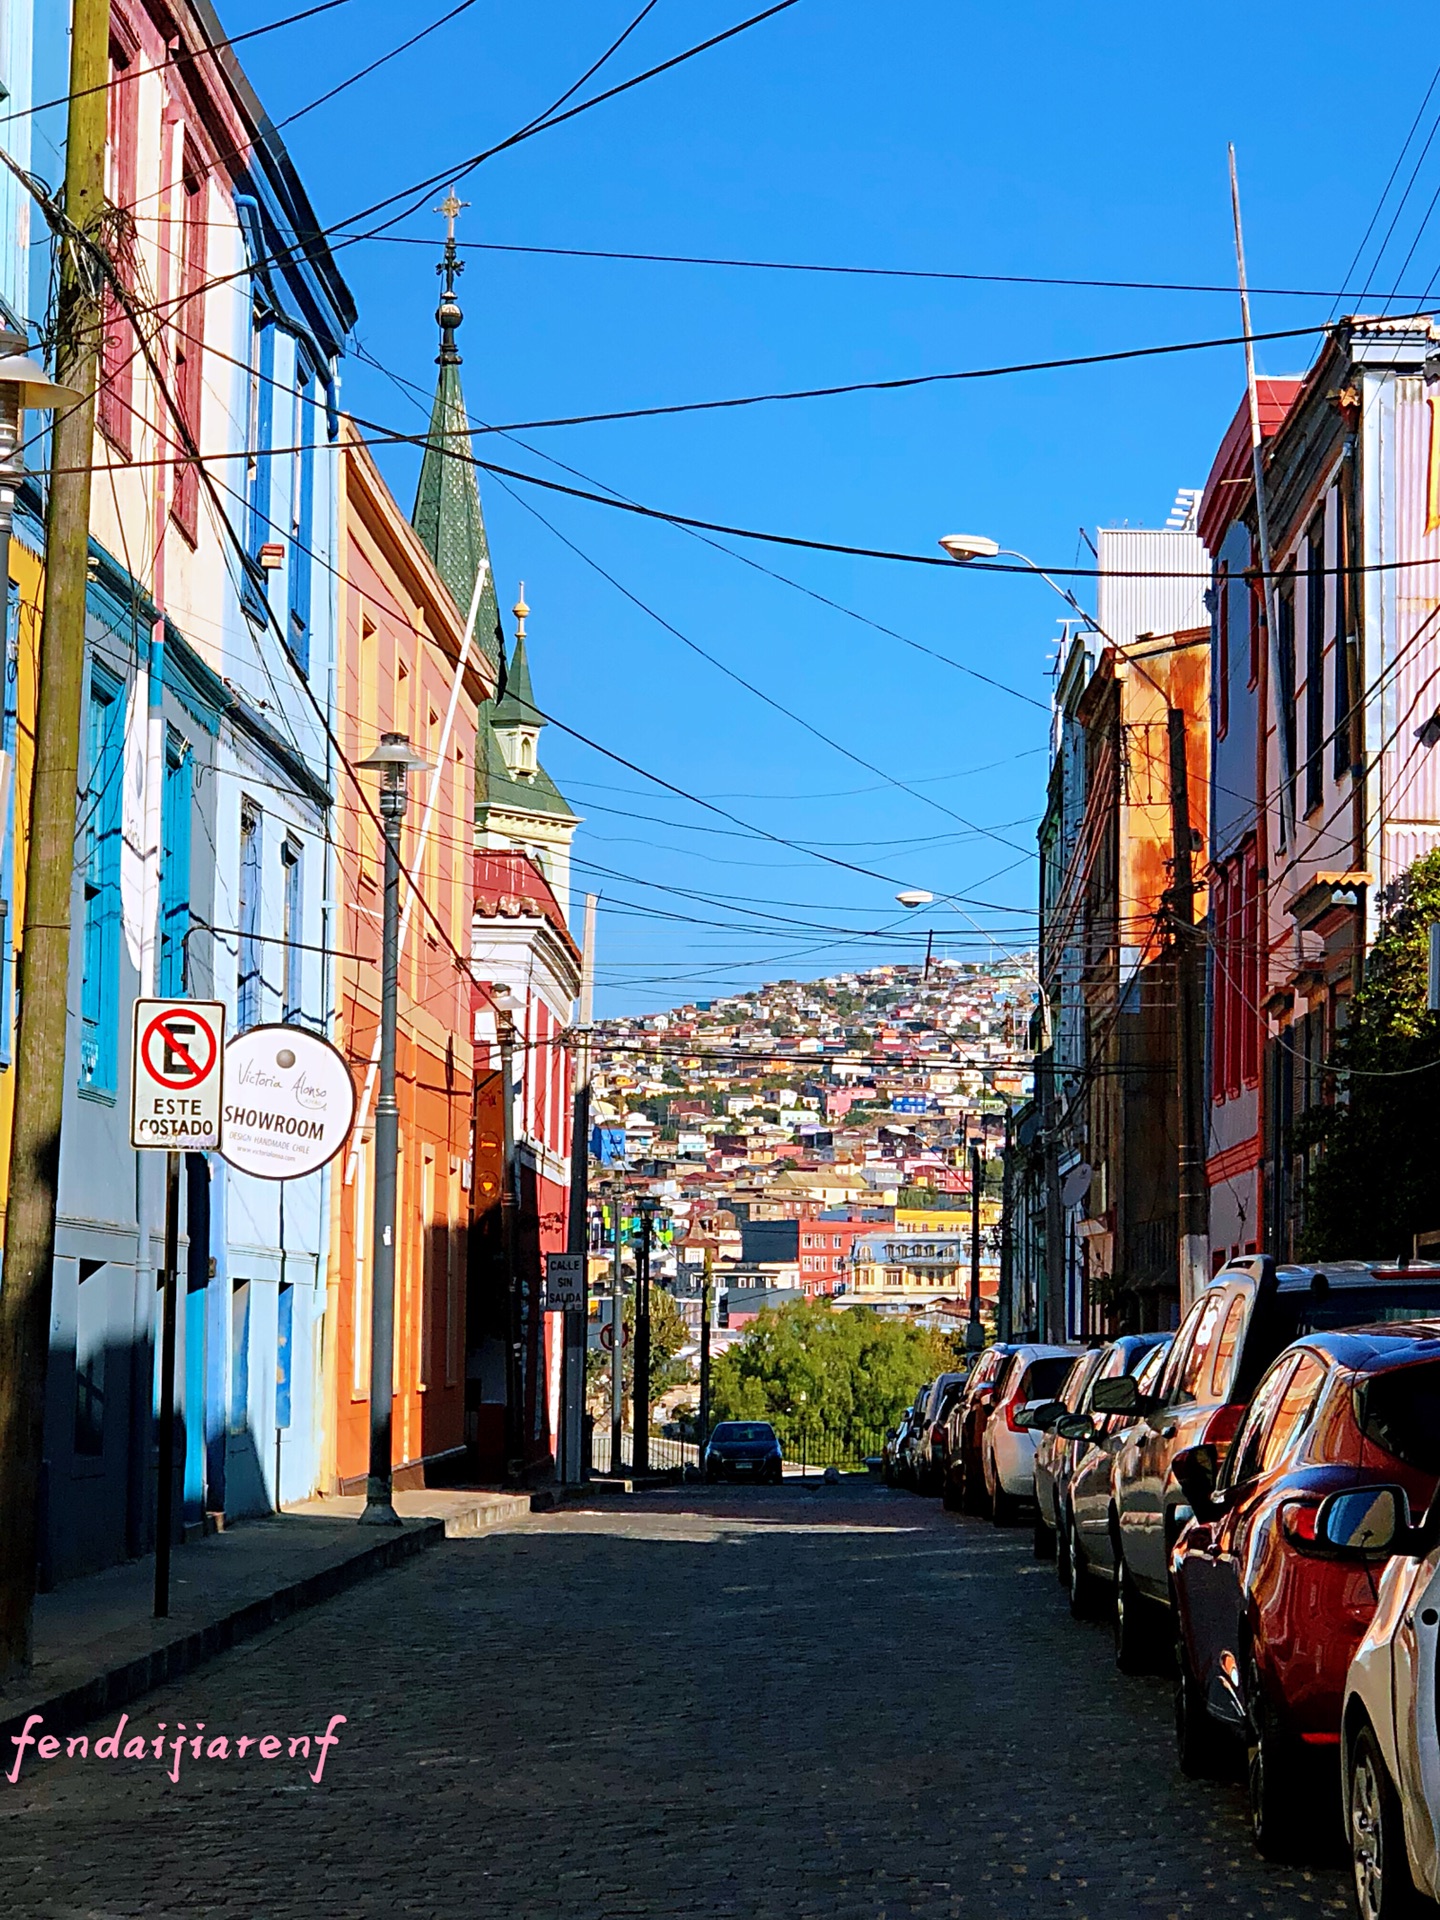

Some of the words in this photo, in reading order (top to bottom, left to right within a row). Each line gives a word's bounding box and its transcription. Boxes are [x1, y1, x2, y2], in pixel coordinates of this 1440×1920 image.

[238, 1058, 283, 1089] Victoria
[290, 1070, 328, 1105] Alonso
[154, 1098, 202, 1116] ESTE
[139, 1118, 213, 1136] COSTADO
[223, 1105, 325, 1141] SHOWROOM
[254, 1136, 291, 1151] HANDMADE
[550, 1260, 580, 1271] CALLE
[557, 1276, 573, 1288] SIN
[549, 1292, 582, 1304] SALIDA
